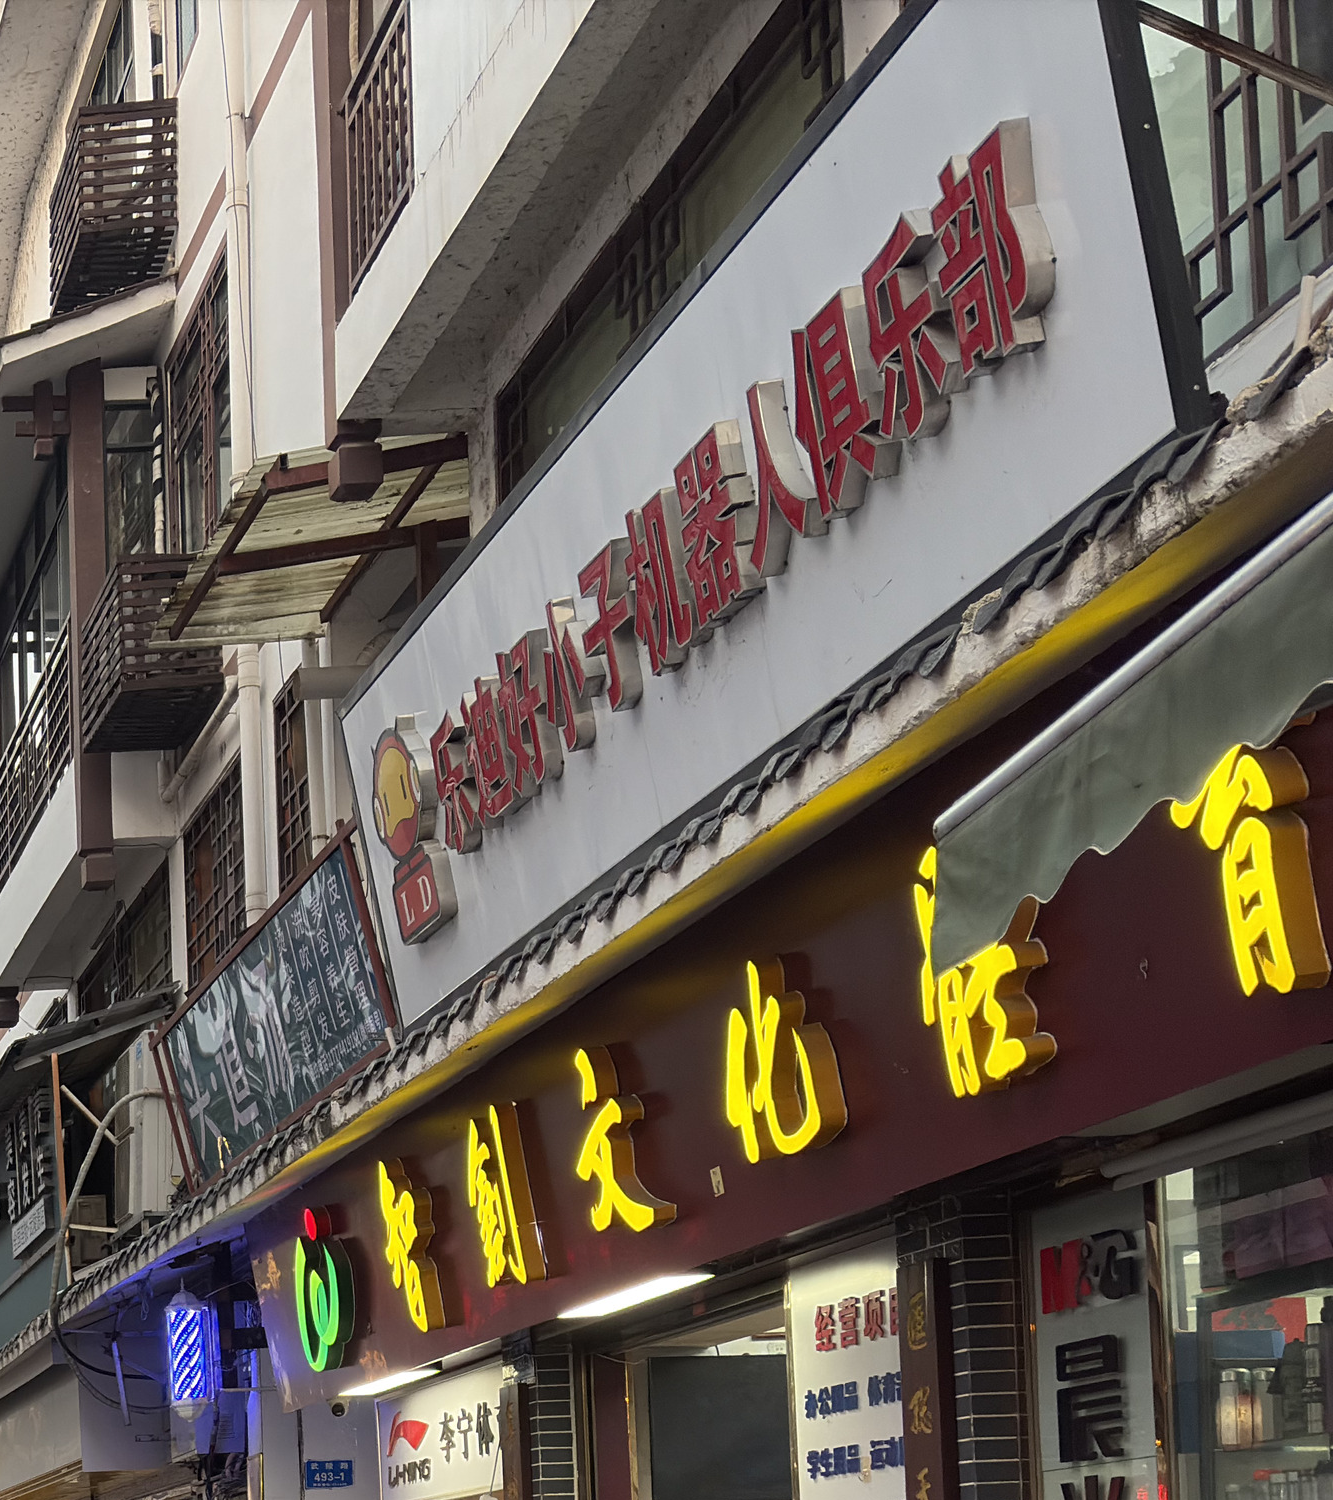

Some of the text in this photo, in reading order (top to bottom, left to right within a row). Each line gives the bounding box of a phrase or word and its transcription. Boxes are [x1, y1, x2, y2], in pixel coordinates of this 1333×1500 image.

[429, 118, 1053, 853] 乐迪好小子机器人俱乐部
[867, 1371, 901, 1407] 体育
[438, 1400, 502, 1464] 李宁体
[314, 1472, 345, 1482] 493-1
[388, 1458, 432, 1489] LI-NING
